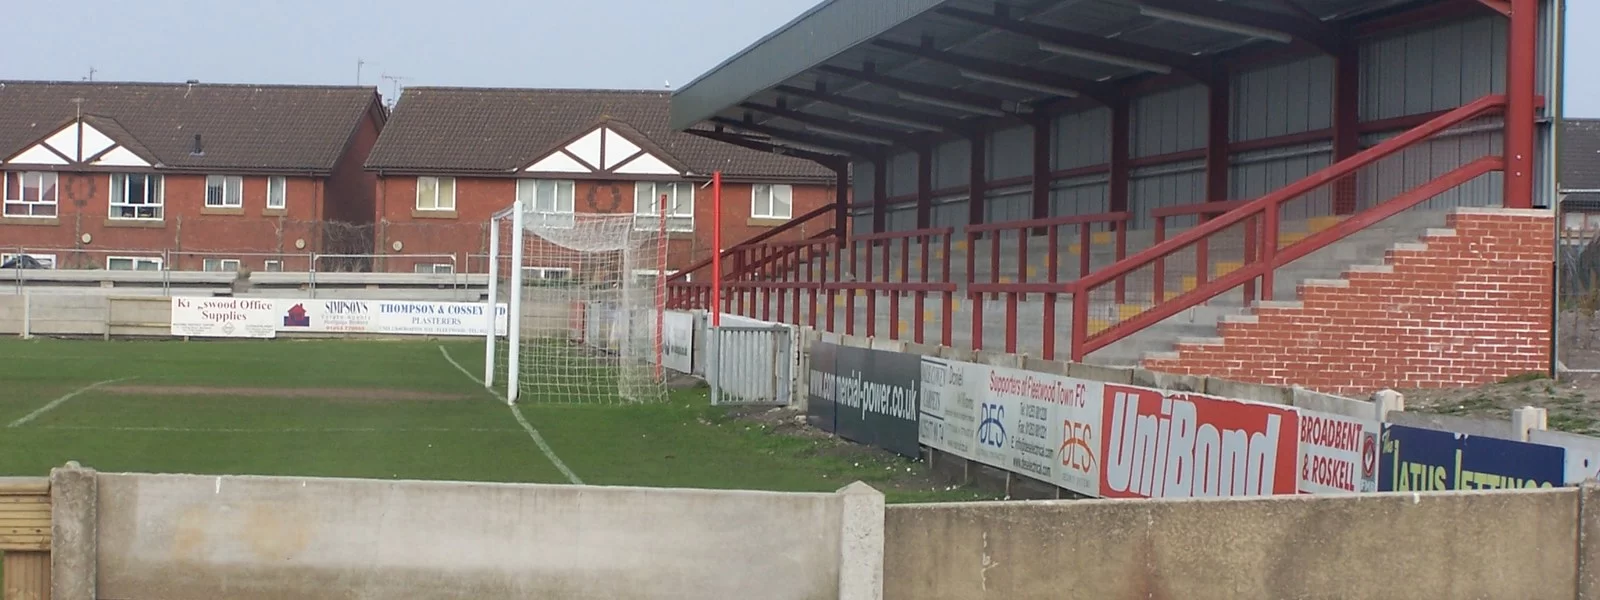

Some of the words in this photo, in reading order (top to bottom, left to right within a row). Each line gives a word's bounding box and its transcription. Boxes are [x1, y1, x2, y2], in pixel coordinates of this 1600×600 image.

[178, 299, 236, 309] Kiswood
[240, 300, 272, 310] Office
[202, 310, 247, 322] Supplies
[325, 301, 369, 314] SIMPSON'S
[380, 304, 435, 314] THOMPSON
[438, 305, 444, 314] &
[448, 304, 484, 315] COSSEY
[412, 316, 461, 325] PLASTERERS
[810, 369, 917, 421] www.commercial-power.co.uk
[990, 370, 1021, 398] Supporters
[1021, 376, 1028, 396] of
[1028, 376, 1056, 403] Fleetwood
[1057, 380, 1074, 407] Town
[1075, 383, 1086, 408] FC
[978, 402, 1006, 448] DES
[1301, 415, 1363, 452] BROADBENT
[1061, 420, 1093, 473] DES
[1106, 391, 1282, 498] UniBond
[1302, 453, 1309, 480] &
[1312, 455, 1355, 492] ROSKELL
